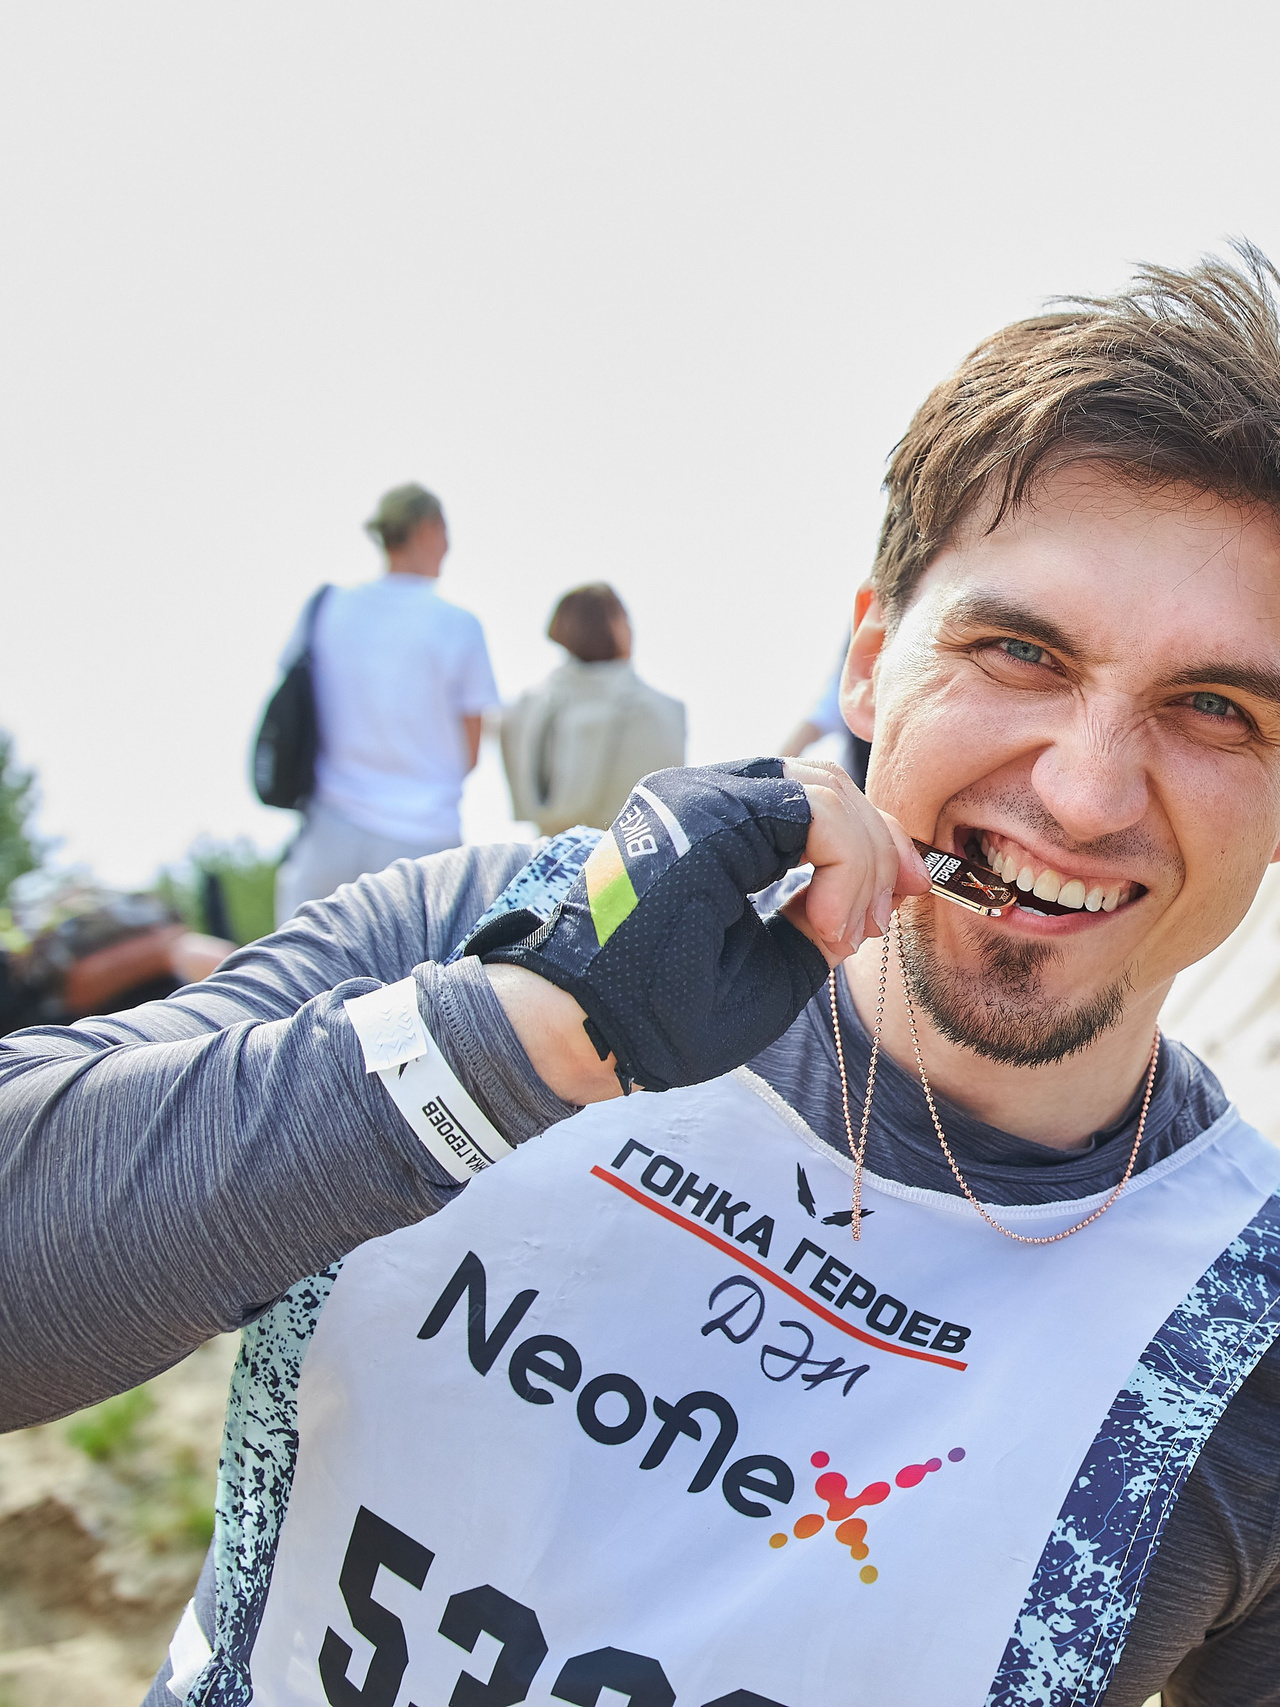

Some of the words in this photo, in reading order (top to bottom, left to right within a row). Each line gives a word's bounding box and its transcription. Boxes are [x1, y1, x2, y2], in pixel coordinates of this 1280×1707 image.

[618, 804, 659, 858] BIKE
[924, 851, 943, 872] НКА
[933, 857, 962, 885] ГЕРОЕВ
[421, 1101, 473, 1158] ГЕРОЕВ
[465, 1153, 489, 1174] НКА
[610, 1138, 773, 1258] ГОНКА
[784, 1237, 972, 1354] ГЕРОЕВ
